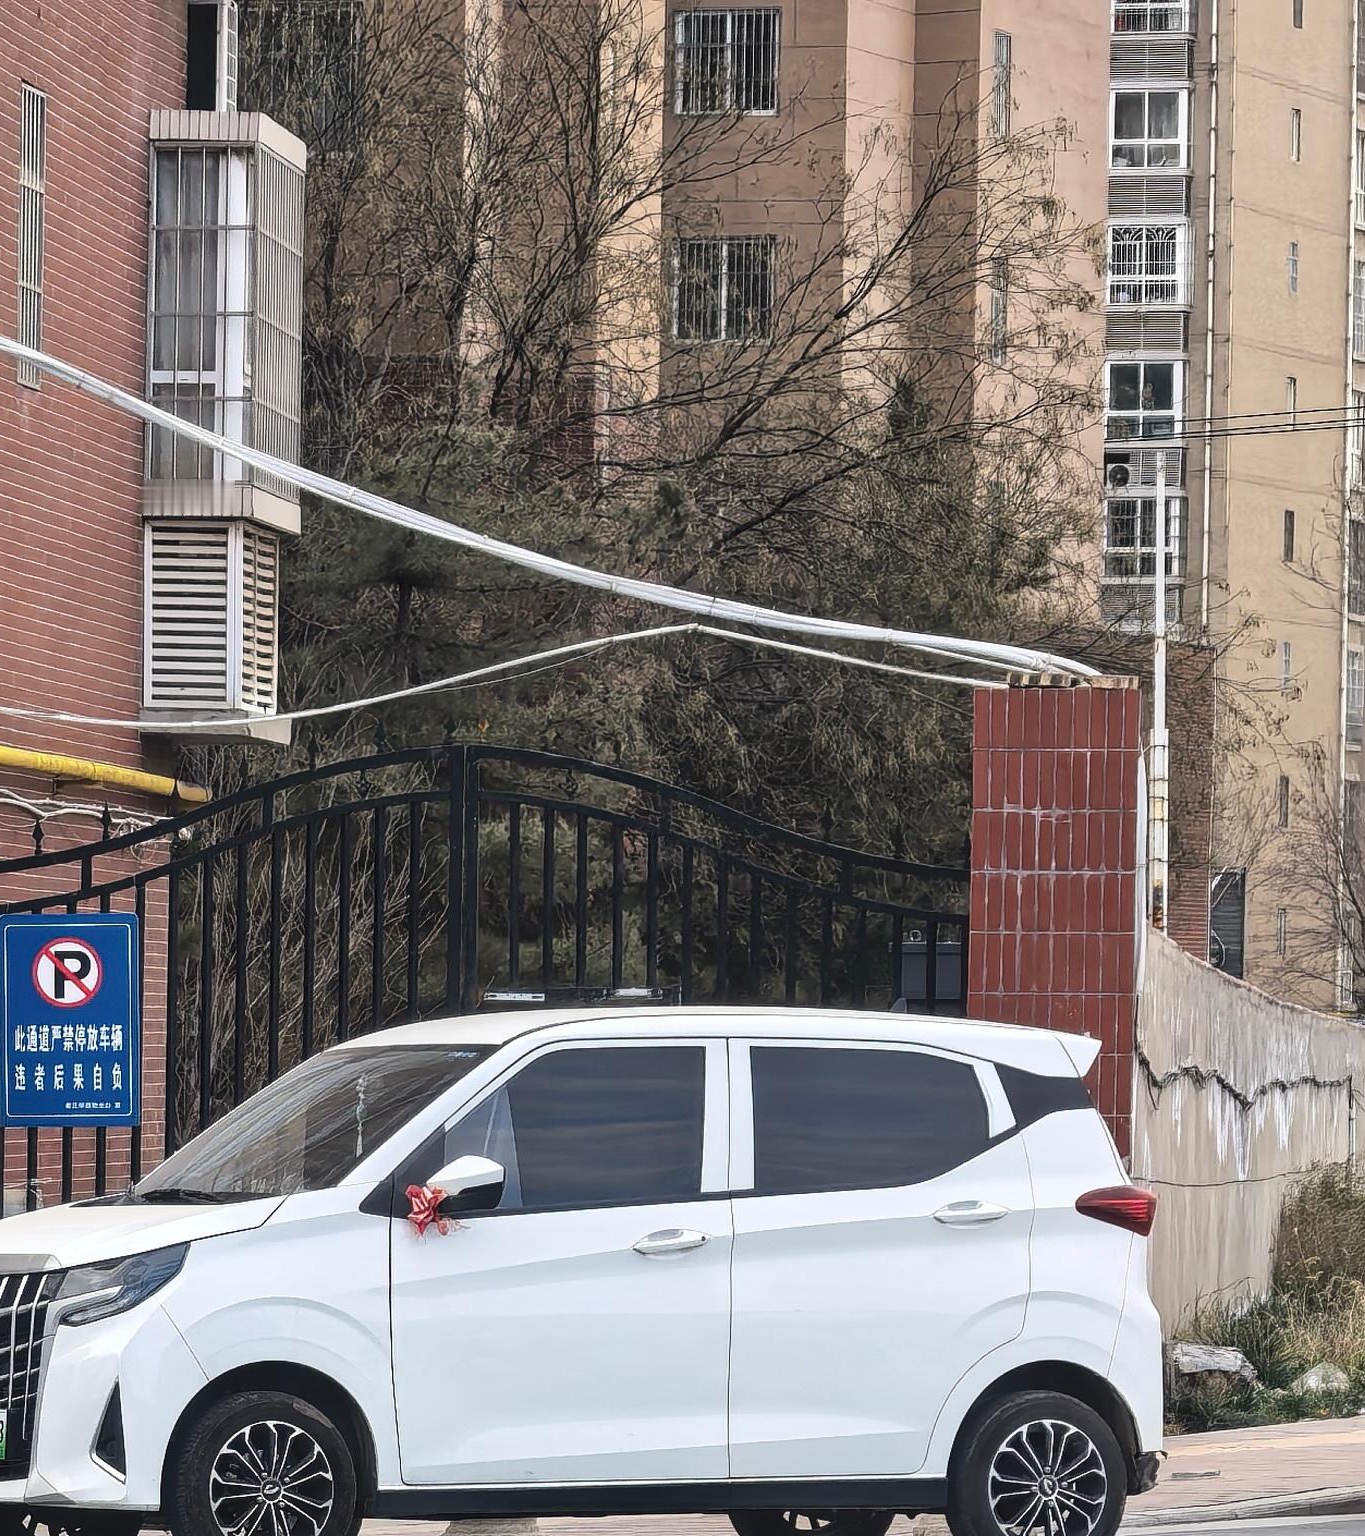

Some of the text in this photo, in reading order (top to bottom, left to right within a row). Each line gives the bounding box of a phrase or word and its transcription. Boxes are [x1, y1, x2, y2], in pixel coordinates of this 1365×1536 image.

[15, 1024, 122, 1052] 此通道严禁停放车辆
[15, 1063, 122, 1091] 违者后果自负
